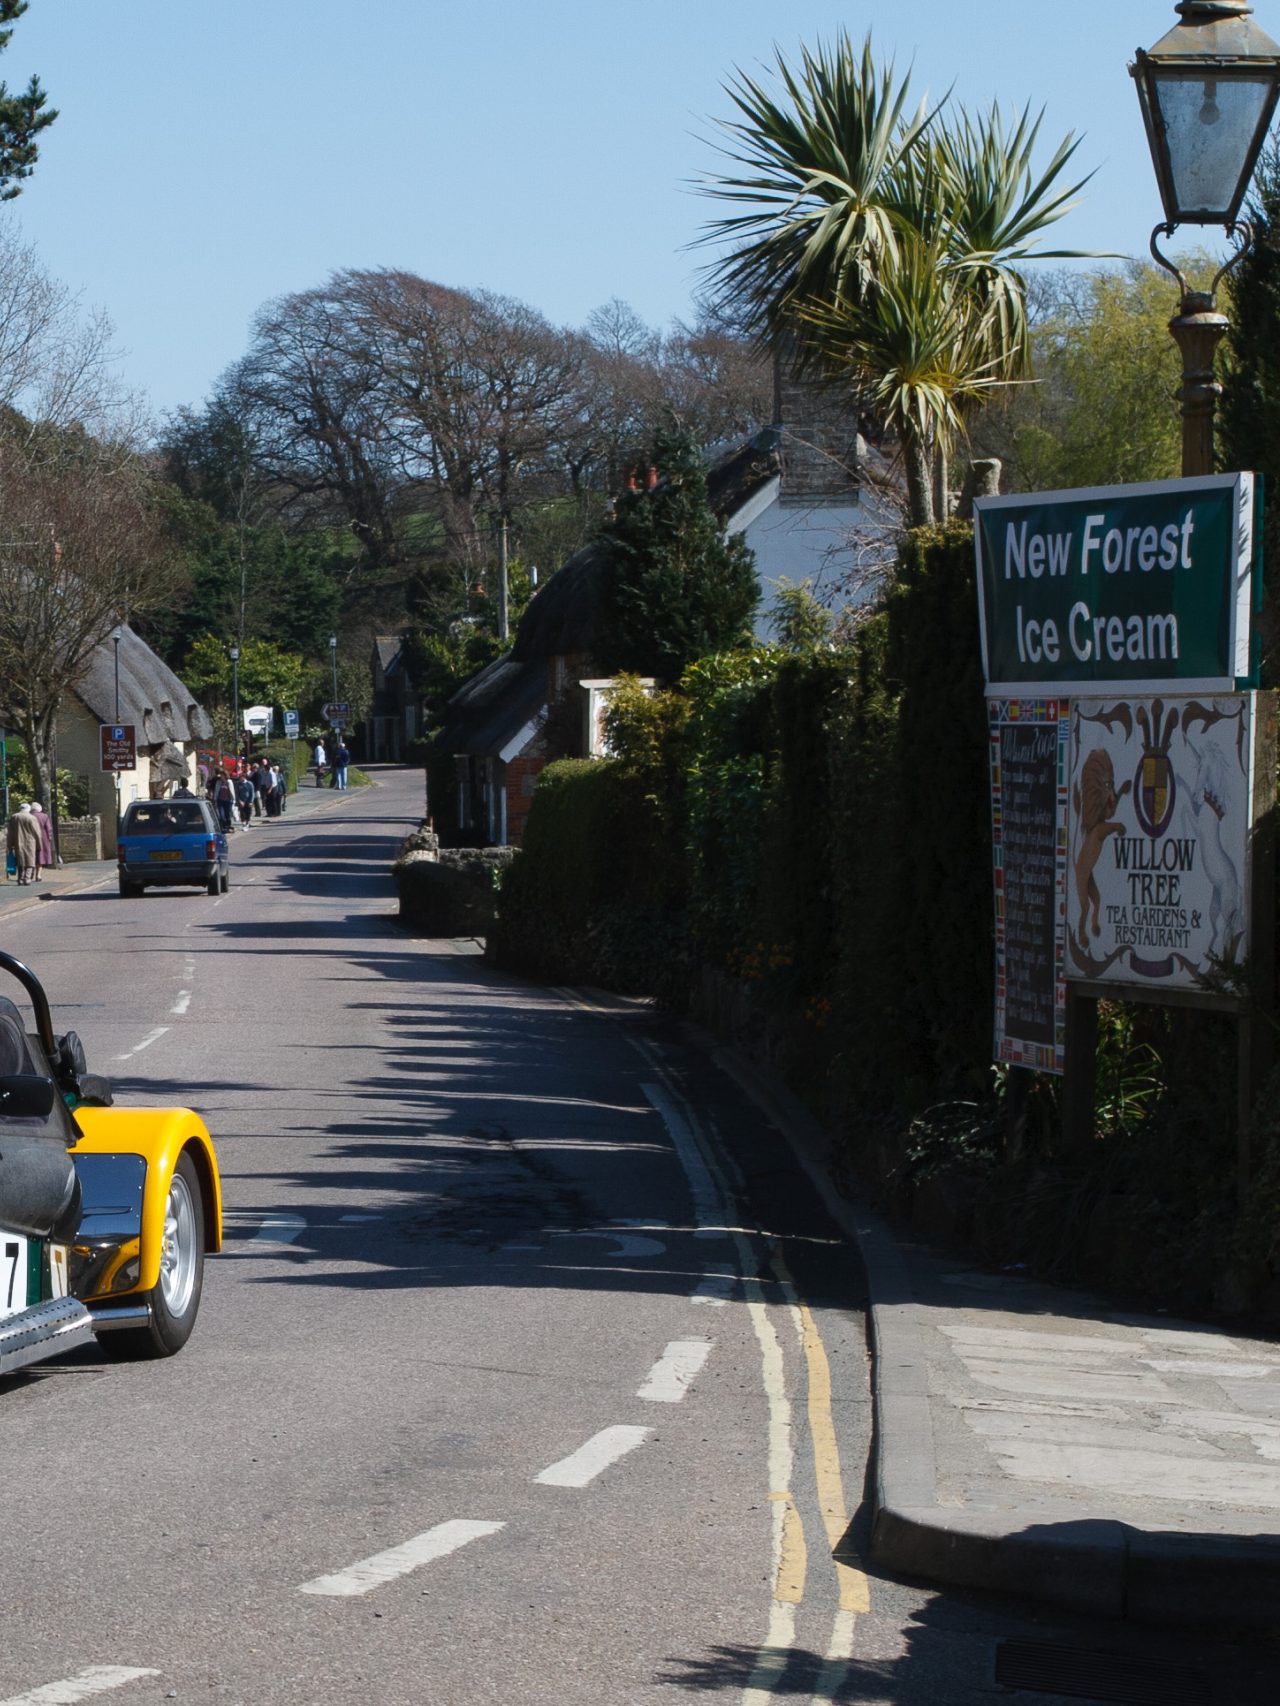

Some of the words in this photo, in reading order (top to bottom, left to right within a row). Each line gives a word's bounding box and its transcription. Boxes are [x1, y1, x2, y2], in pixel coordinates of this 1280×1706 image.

[1004, 521, 1072, 580] New
[1081, 508, 1194, 574] Forest
[1016, 605, 1060, 663] Ice
[1069, 601, 1179, 663] Cream
[115, 729, 122, 739] P
[286, 713, 295, 724] P
[1113, 837, 1196, 871] WILLOW
[1127, 874, 1181, 907] TREE
[1106, 906, 1127, 925] TEA
[1131, 907, 1187, 928] GARDENS
[1191, 910, 1202, 928] &
[1115, 927, 1191, 948] RESTAURANT
[6, 1243, 19, 1308] 7
